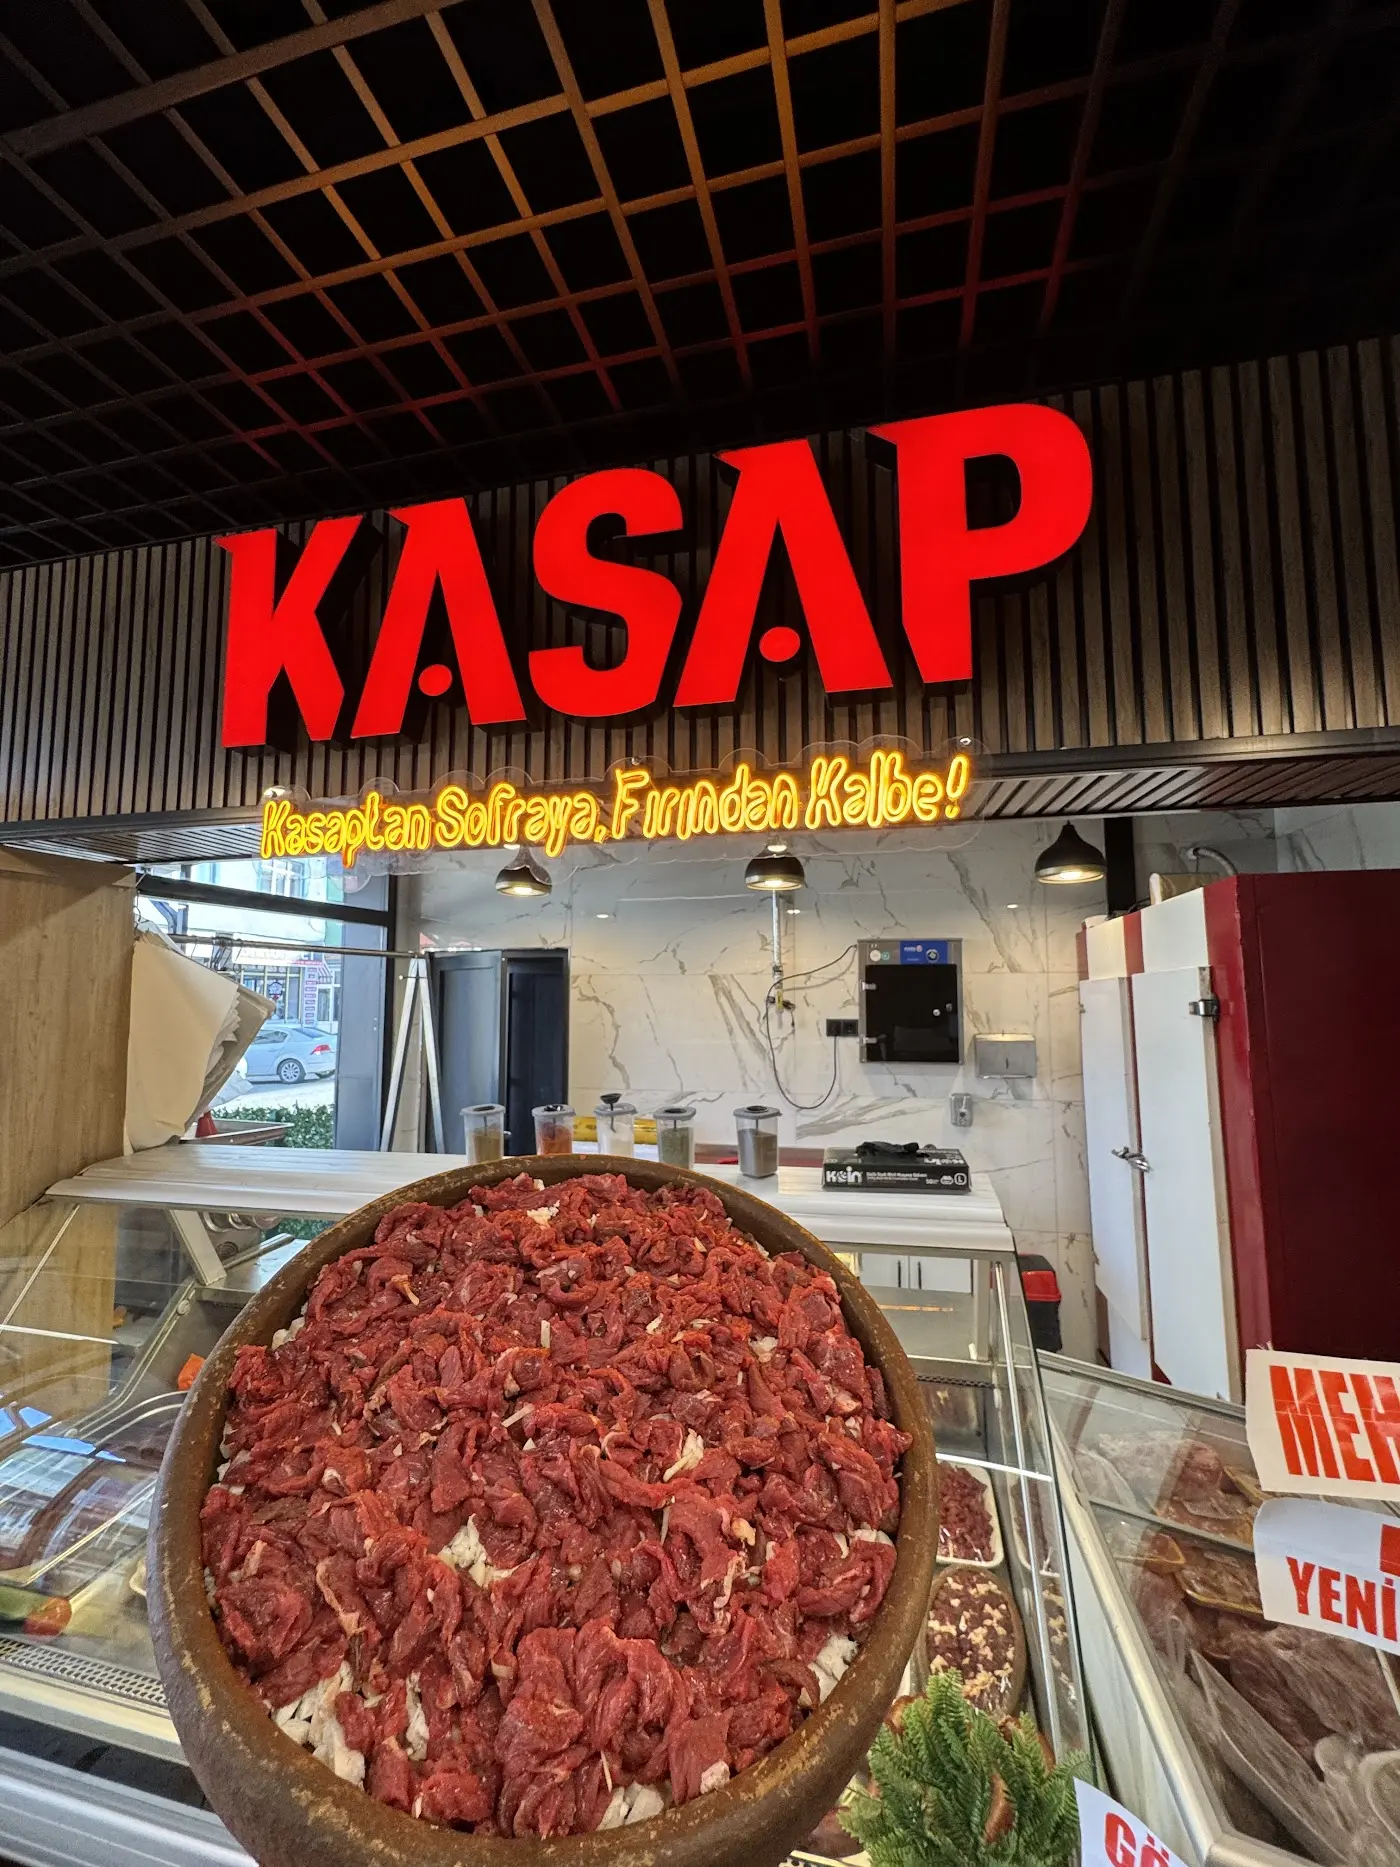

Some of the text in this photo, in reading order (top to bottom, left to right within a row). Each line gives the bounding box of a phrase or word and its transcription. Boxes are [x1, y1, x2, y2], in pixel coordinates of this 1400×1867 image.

[214, 402, 1094, 749] KASAP
[260, 791, 432, 867] Kasaptan
[434, 781, 610, 858] Sofraya,
[804, 749, 971, 831] Kalbe!
[1285, 1555, 1398, 1643] YENİ
